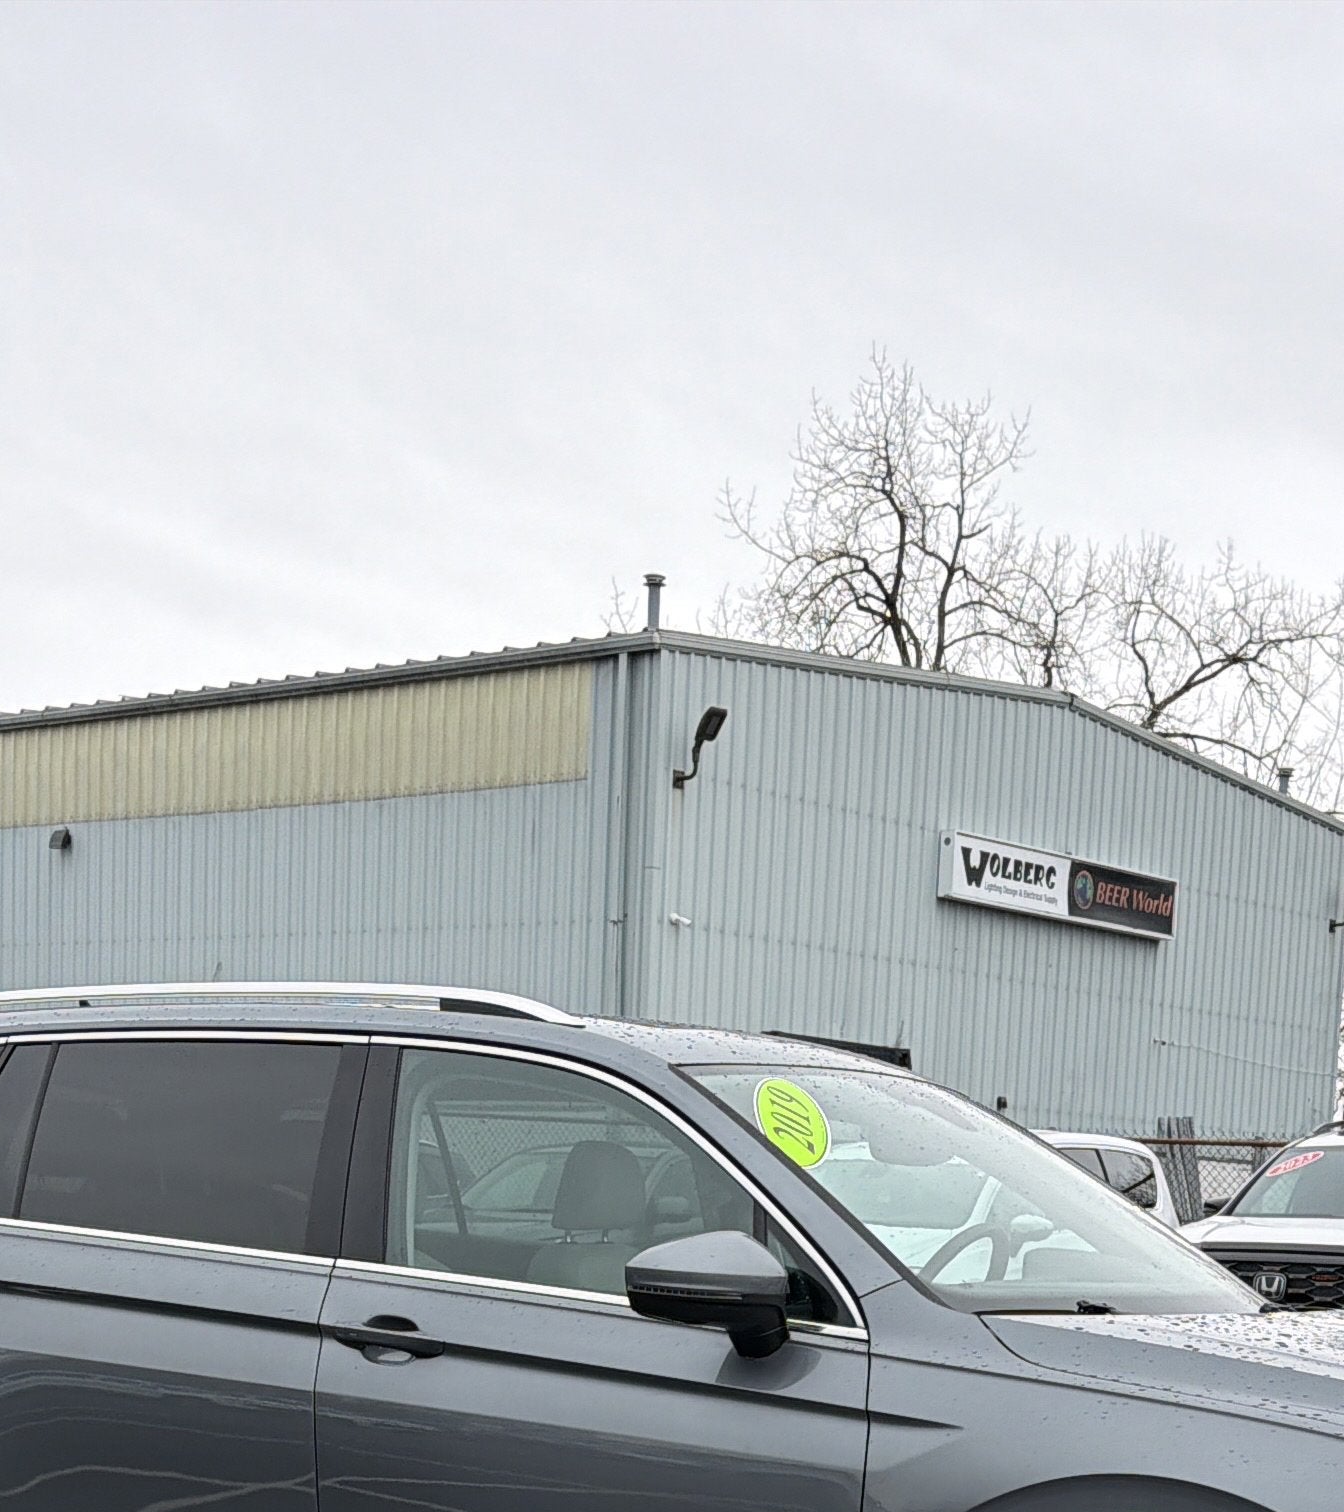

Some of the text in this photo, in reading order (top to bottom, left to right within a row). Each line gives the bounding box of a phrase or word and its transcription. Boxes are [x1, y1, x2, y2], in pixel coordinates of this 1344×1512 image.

[961, 846, 1057, 890] WOLBERG
[1096, 882, 1173, 918] BEER World
[767, 1086, 815, 1155] 2019
